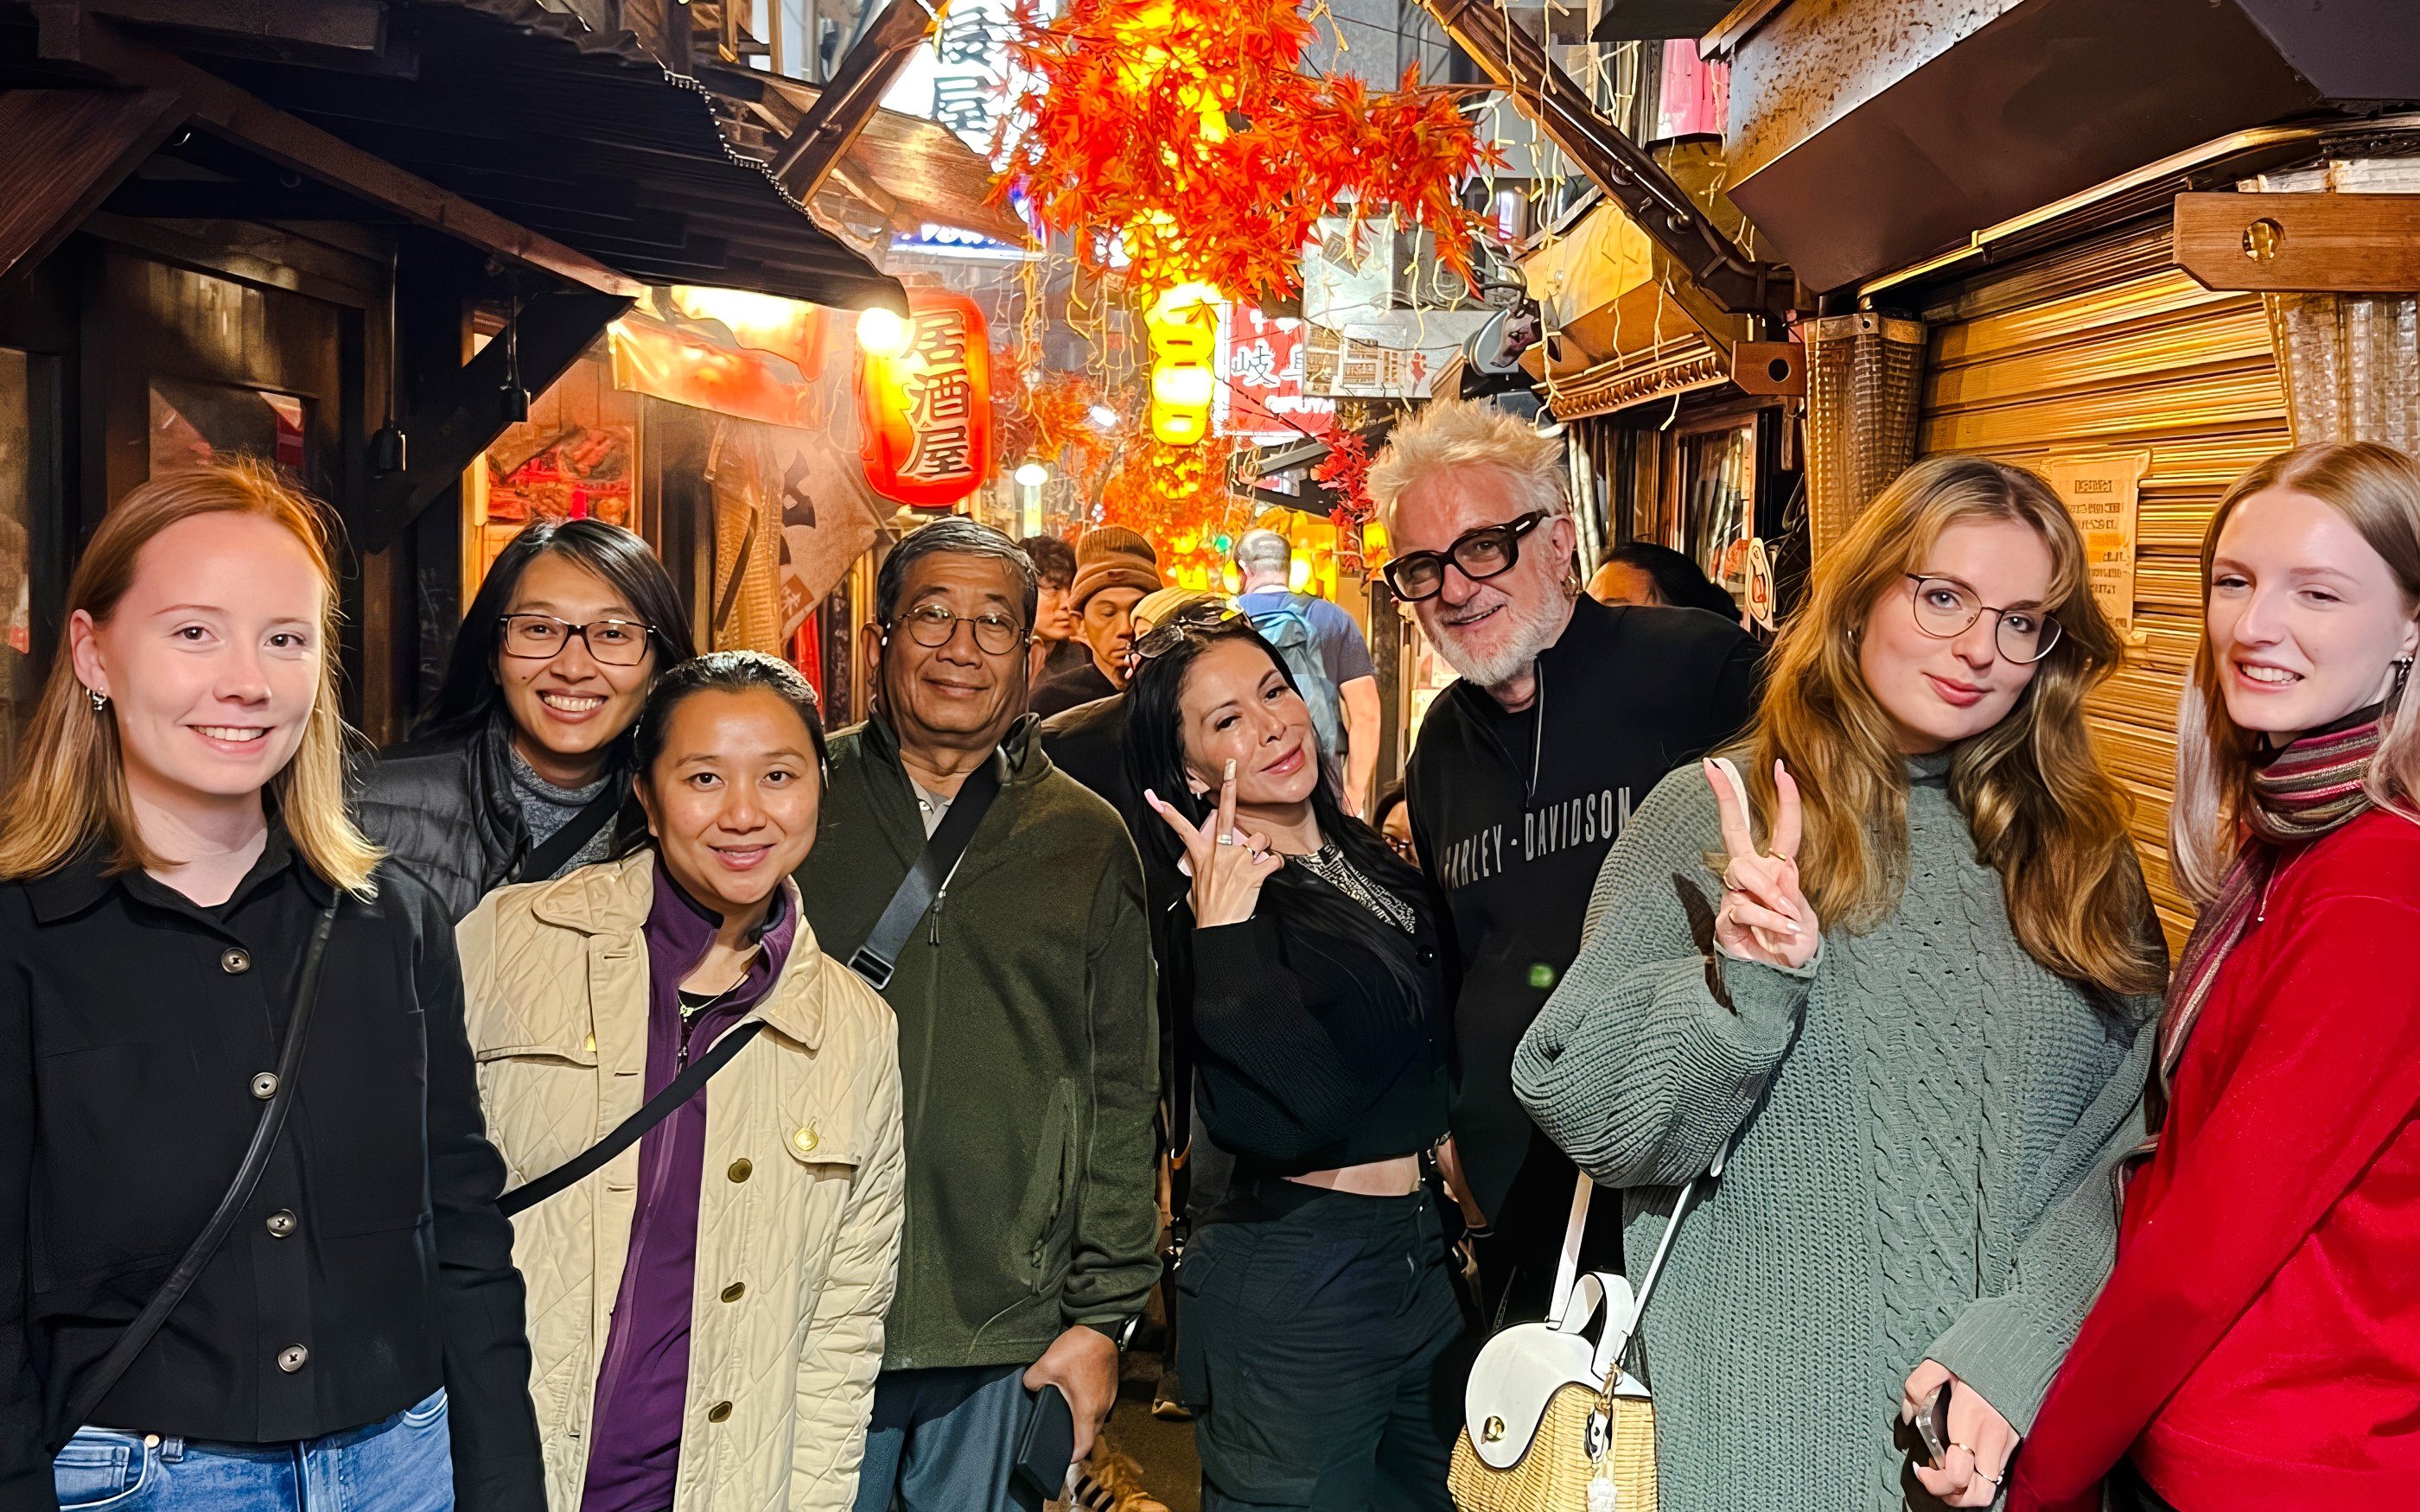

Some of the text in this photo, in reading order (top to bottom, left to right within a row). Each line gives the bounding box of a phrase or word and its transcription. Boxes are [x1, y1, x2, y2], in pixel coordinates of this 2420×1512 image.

[901, 310, 971, 478] 居酒屋
[1525, 787, 1631, 861] DAVIDSON
